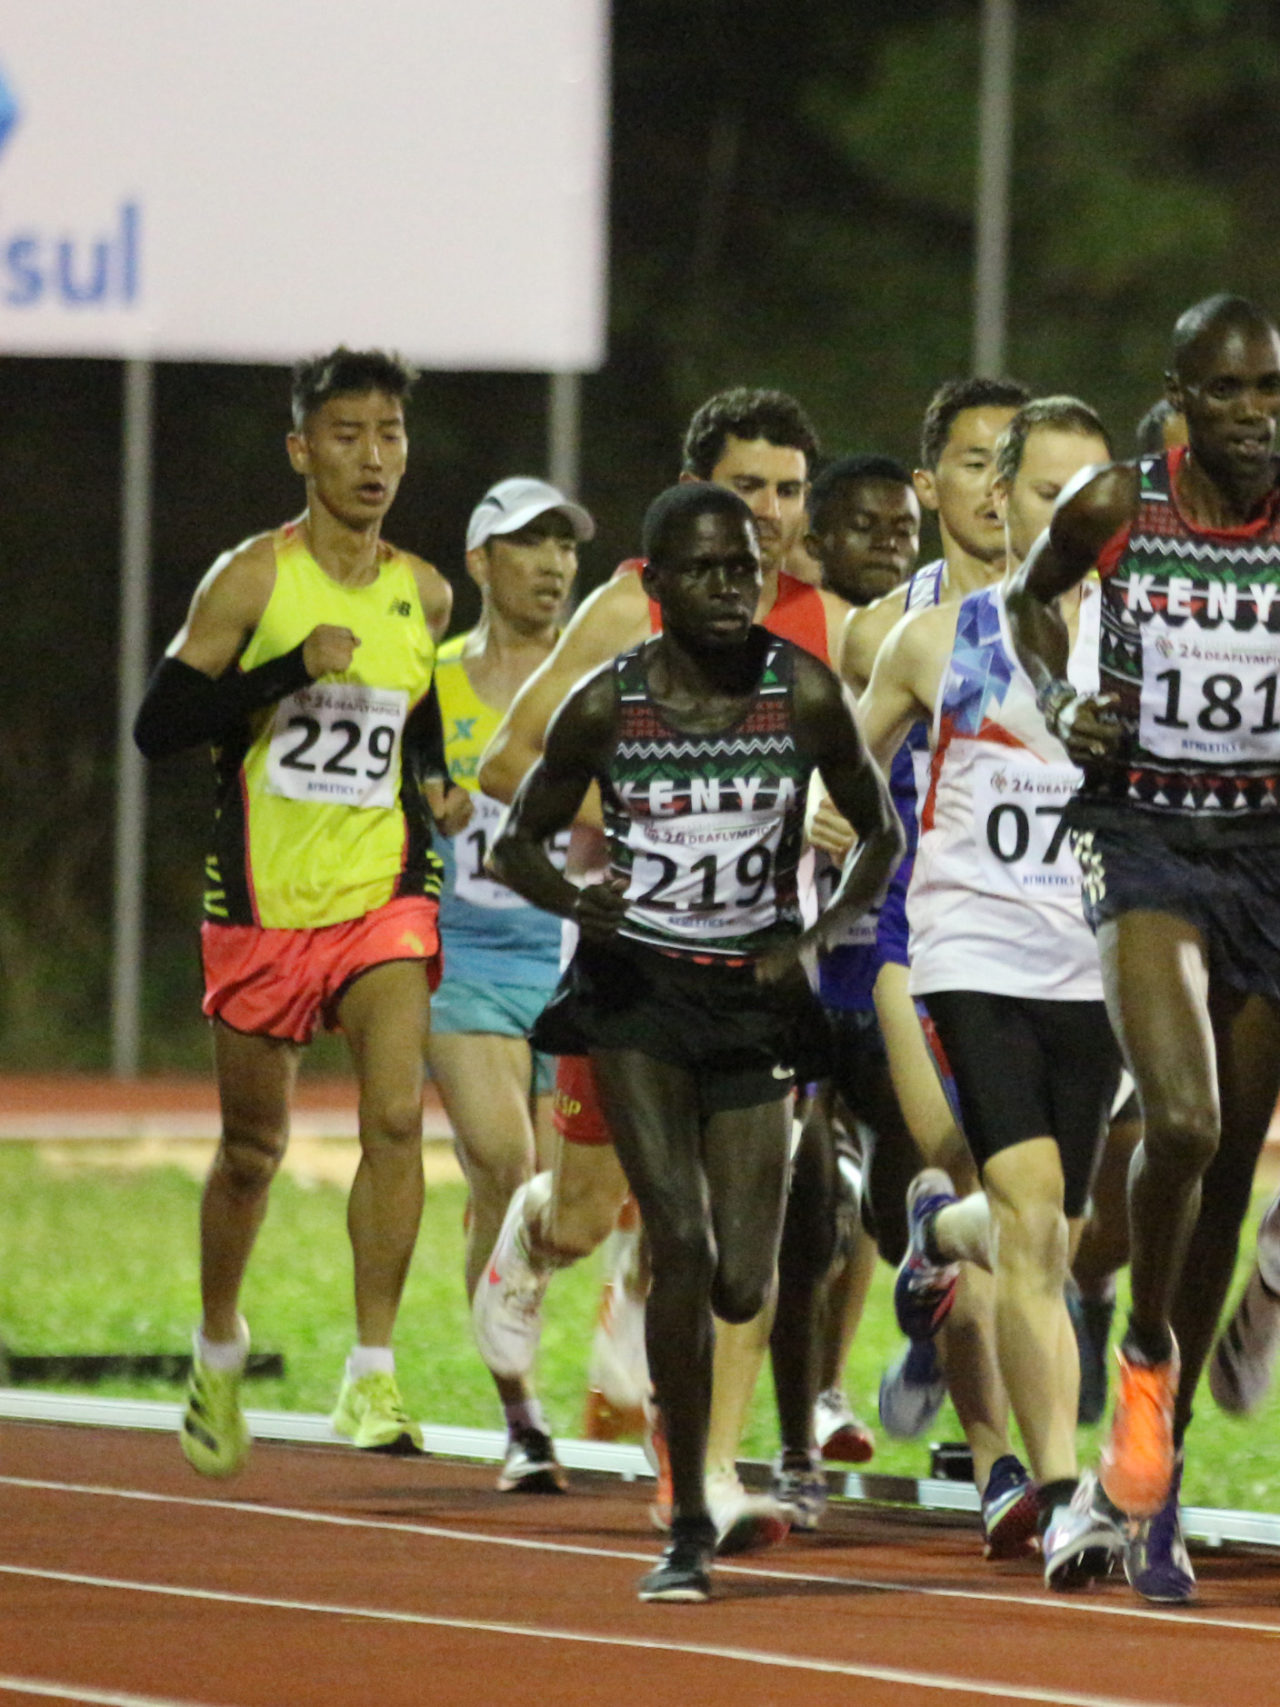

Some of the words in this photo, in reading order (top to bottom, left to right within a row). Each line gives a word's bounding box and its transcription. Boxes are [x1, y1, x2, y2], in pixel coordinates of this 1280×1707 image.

[6, 203, 139, 306] sul
[1179, 644, 1202, 659] 24
[1153, 668, 1280, 735] 181
[279, 715, 396, 780] 229
[1012, 778, 1034, 793] 24
[663, 831, 686, 845] 24
[689, 827, 772, 845] DEAFLYMPIC
[986, 803, 1070, 864] 07
[636, 845, 771, 911] 219
